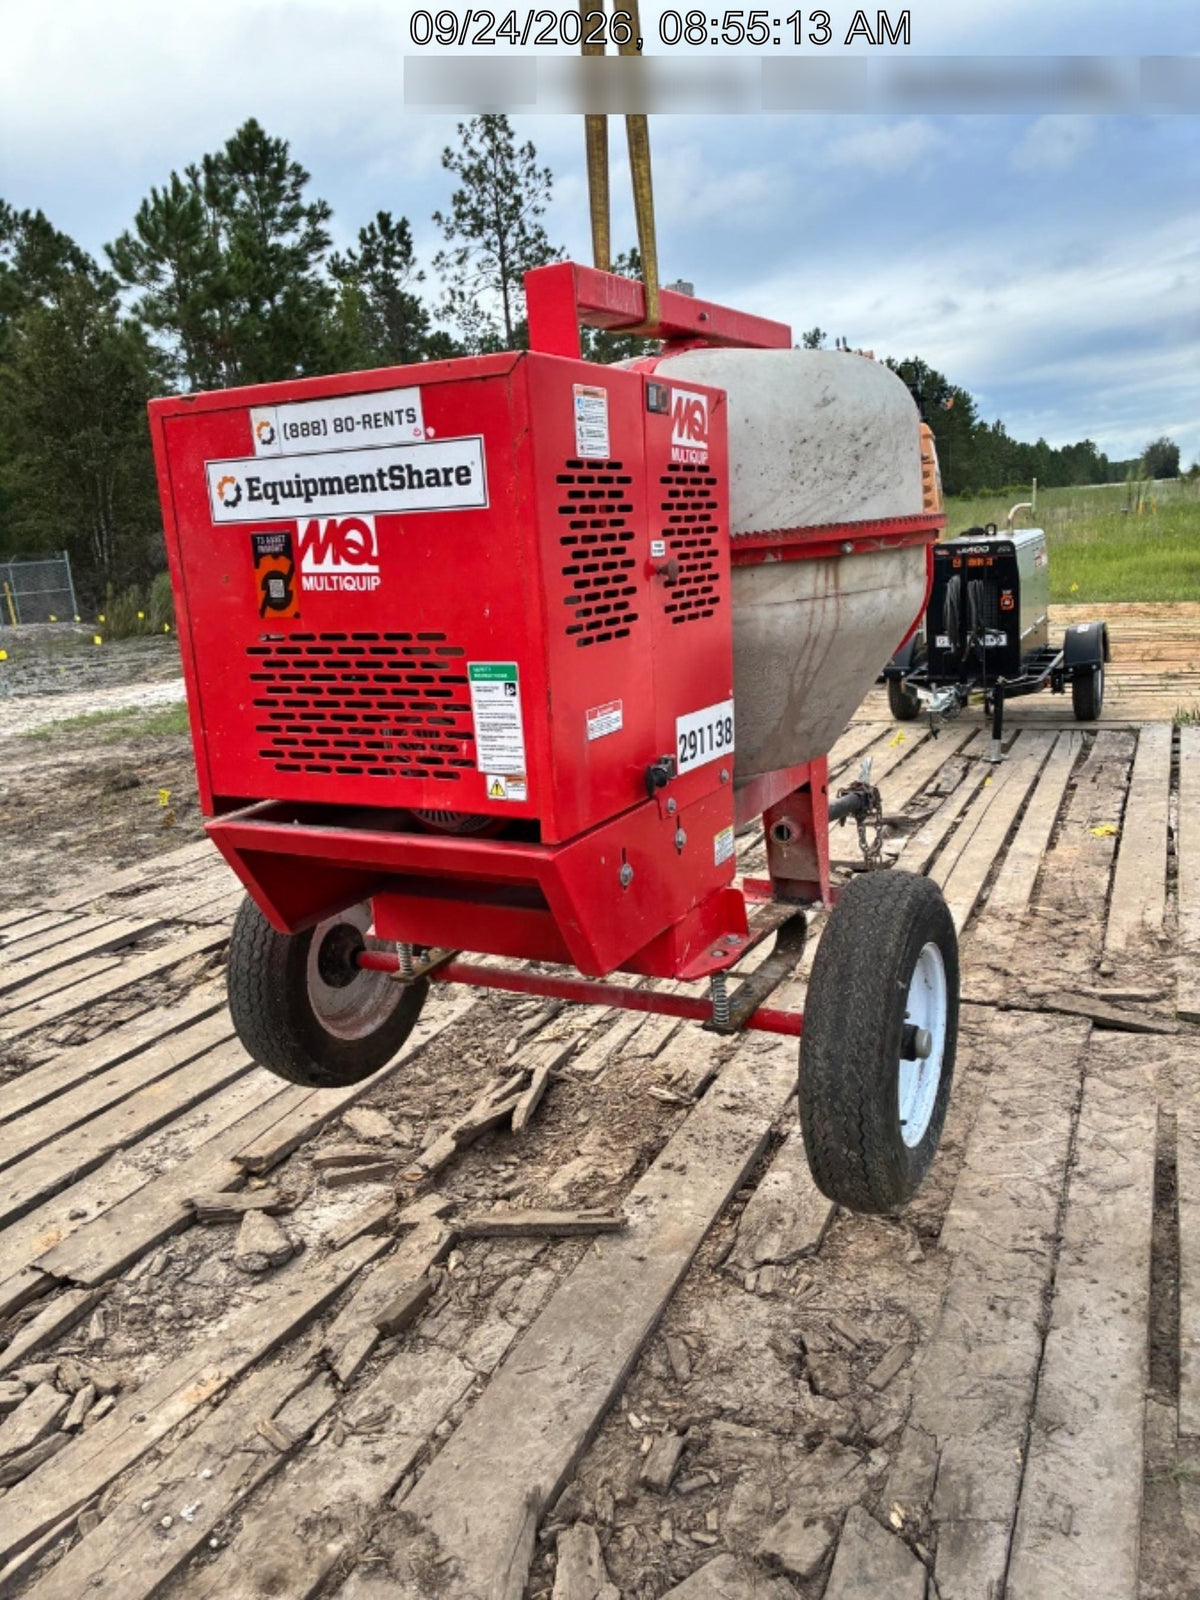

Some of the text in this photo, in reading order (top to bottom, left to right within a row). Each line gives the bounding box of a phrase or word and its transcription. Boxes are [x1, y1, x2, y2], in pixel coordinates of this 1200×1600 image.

[282, 408, 417, 440] (888) 80-RENTS
[672, 396, 708, 444] MQ
[672, 448, 708, 464] MULTIQUIP
[245, 463, 472, 505] EquipmentShare
[299, 517, 380, 567] MQ
[302, 575, 381, 591] MULTIQUIP
[678, 716, 733, 764] 291138
